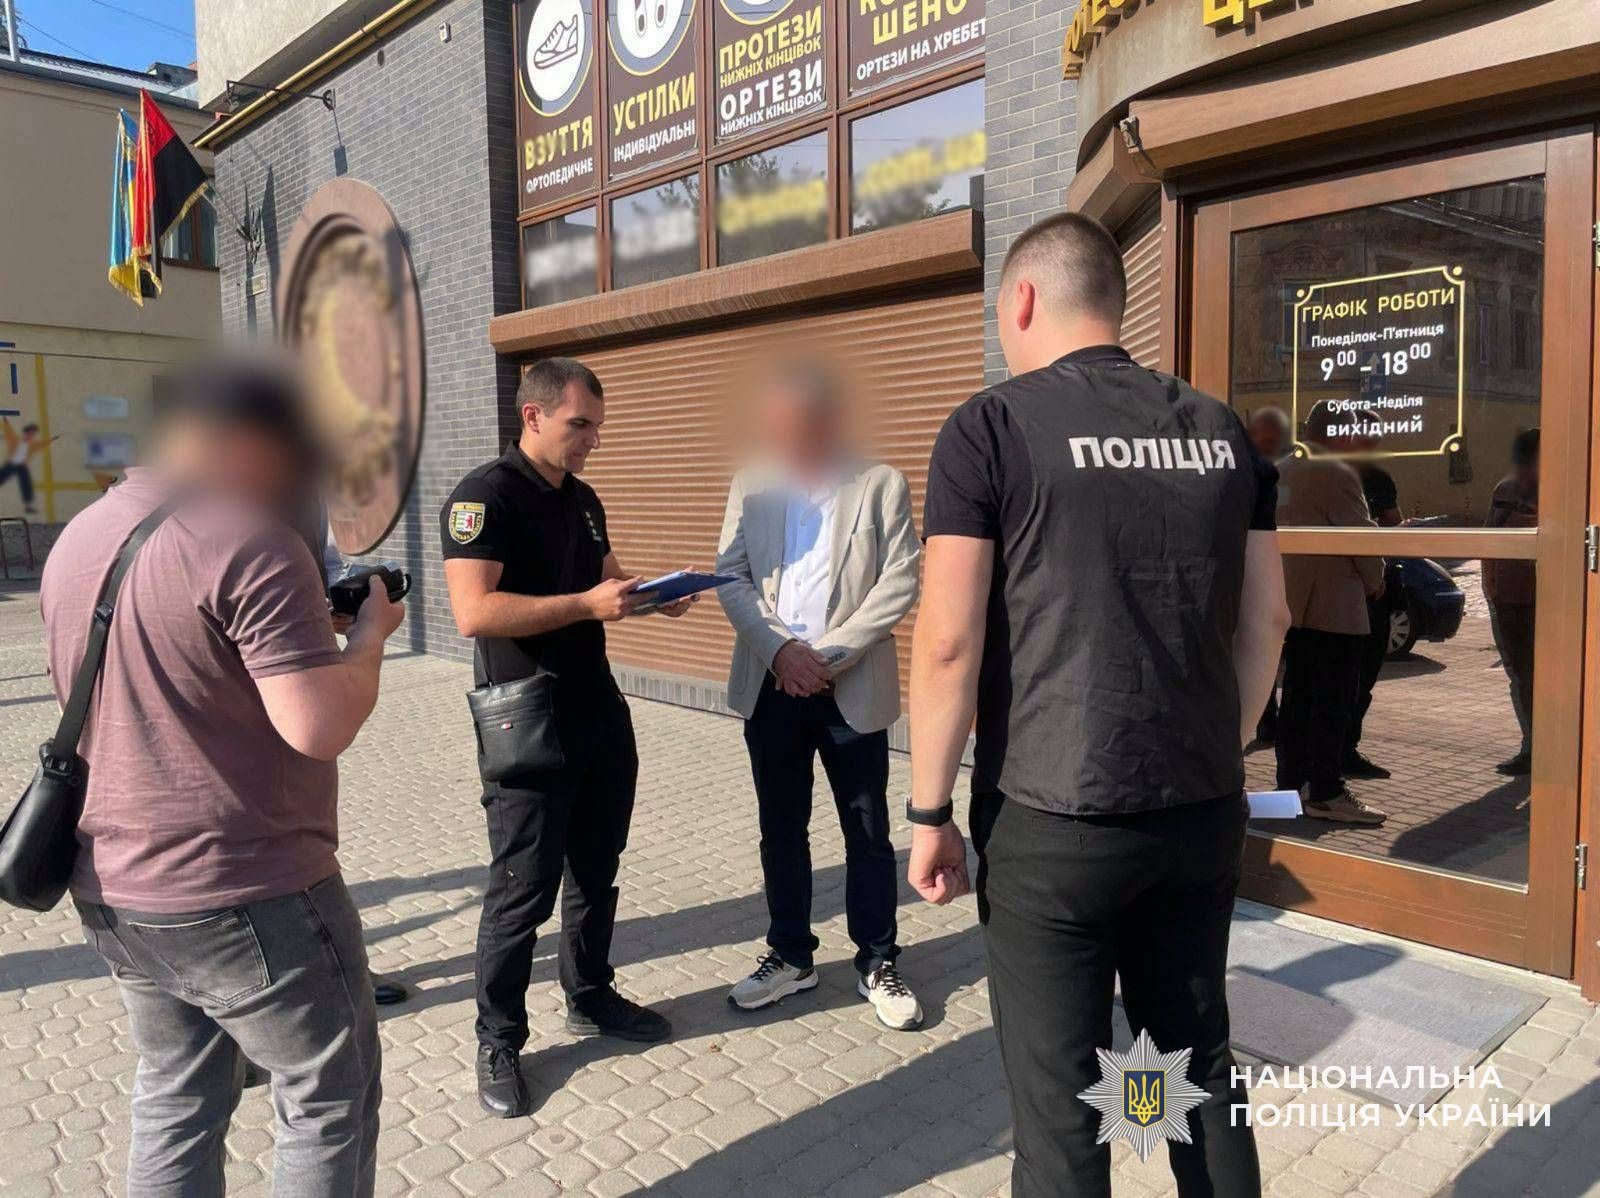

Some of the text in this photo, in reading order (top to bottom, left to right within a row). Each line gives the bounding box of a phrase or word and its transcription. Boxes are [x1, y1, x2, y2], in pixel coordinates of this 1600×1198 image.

[719, 5, 822, 74] ПРОТЕЗИ
[720, 36, 821, 89] НИЖНІХ КІНЦІВОК
[856, 17, 987, 81] ОРТЕЗИ НА ХРЕБЕТ
[613, 72, 696, 137] УСТІЛКИ
[720, 58, 822, 121] ОРТЕЗИ
[720, 88, 822, 135] НИЖНІХ КІНЦІВОК
[524, 115, 594, 171] ВЗУТТЯ
[613, 119, 696, 163] ІНДИВІДУАЛЬНІ
[525, 157, 594, 193] ОРТОПЕДИЧНЕ
[1302, 287, 1455, 322] ГРАФІК РОБОТИ
[1326, 396, 1423, 414] Субота-Неділя
[1326, 415, 1423, 437] вихідний
[1068, 436, 1236, 475] ПОЛІЦІЯ
